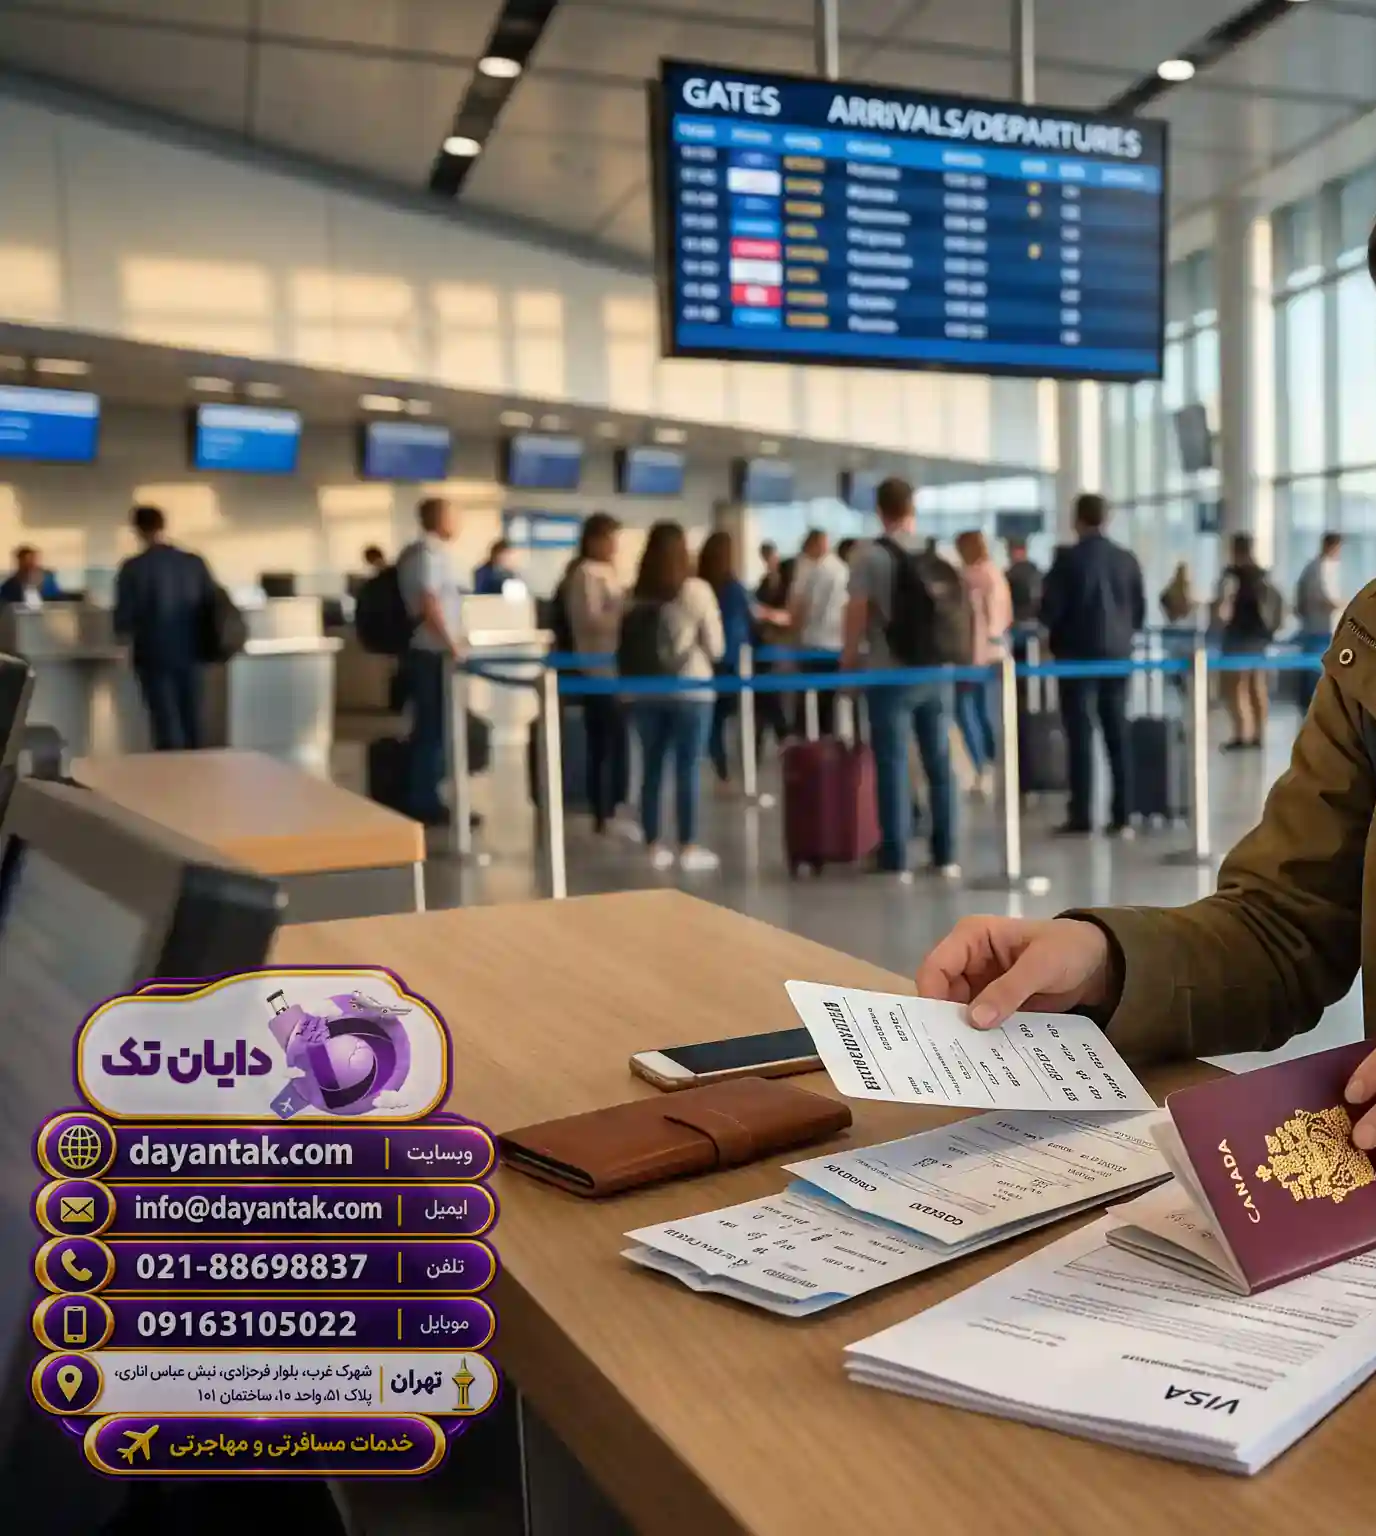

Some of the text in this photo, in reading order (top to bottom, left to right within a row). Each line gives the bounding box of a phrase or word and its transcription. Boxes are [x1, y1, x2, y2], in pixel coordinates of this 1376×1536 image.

[682, 77, 782, 116] GATES
[827, 94, 1142, 158] ARRIVALS/DEPARTURES
[1218, 1138, 1261, 1223] CANADA
[1164, 1384, 1240, 1415] VISA
